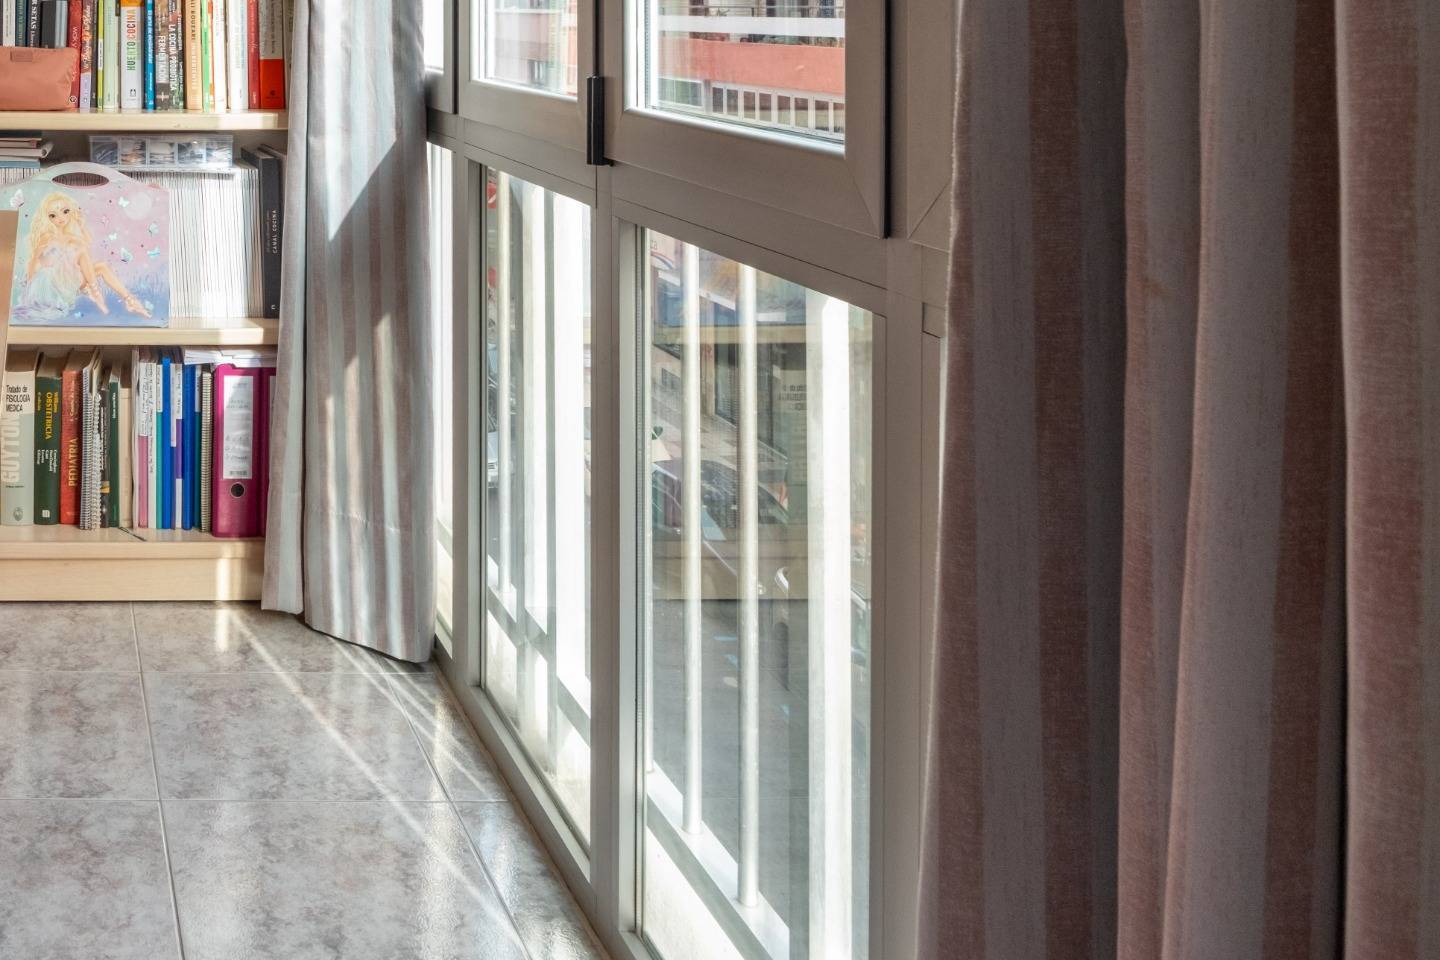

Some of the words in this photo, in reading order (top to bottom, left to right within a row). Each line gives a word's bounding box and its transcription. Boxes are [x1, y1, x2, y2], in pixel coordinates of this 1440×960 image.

[30, 6, 38, 30] SETAS
[126, 9, 136, 40] COCINA
[168, 23, 177, 32] LA
[126, 41, 136, 71] HUERTO
[168, 33, 177, 55] COCINA
[45, 391, 54, 440] OBSTETRICIA
[1, 416, 20, 483] GUYTON
